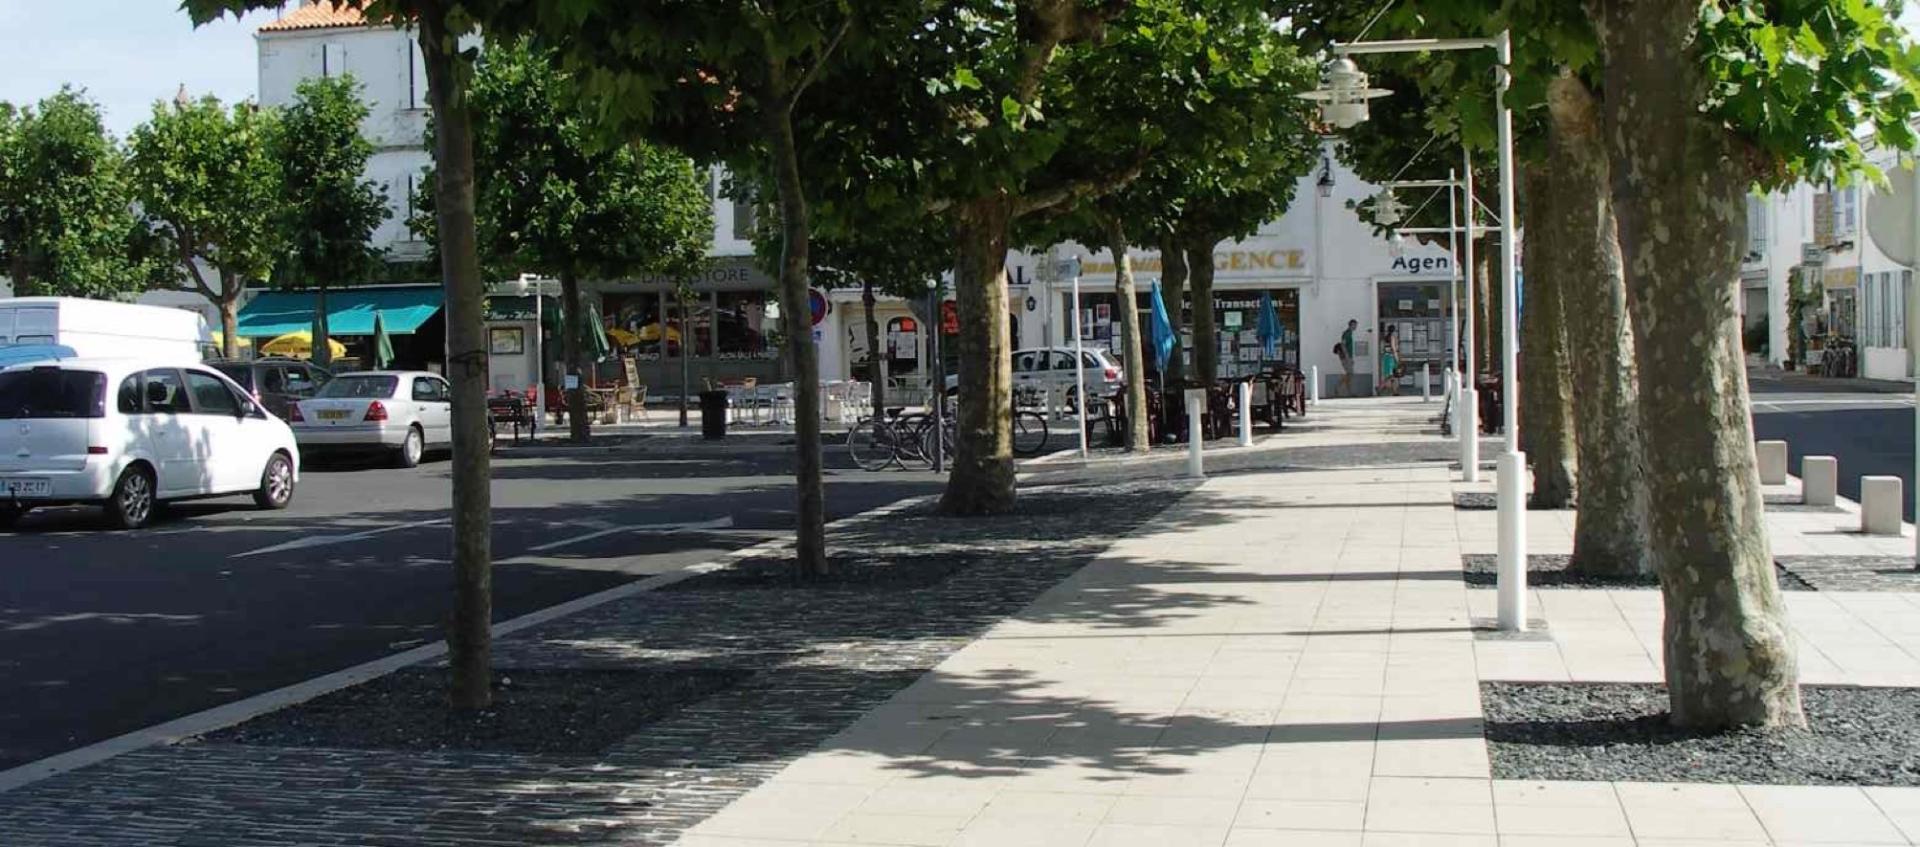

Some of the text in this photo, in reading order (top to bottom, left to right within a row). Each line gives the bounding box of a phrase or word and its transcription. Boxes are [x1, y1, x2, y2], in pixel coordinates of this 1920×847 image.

[1212, 250, 1305, 271] GENCE
[1392, 256, 1448, 273] Agen
[642, 267, 749, 283] DRSTORE
